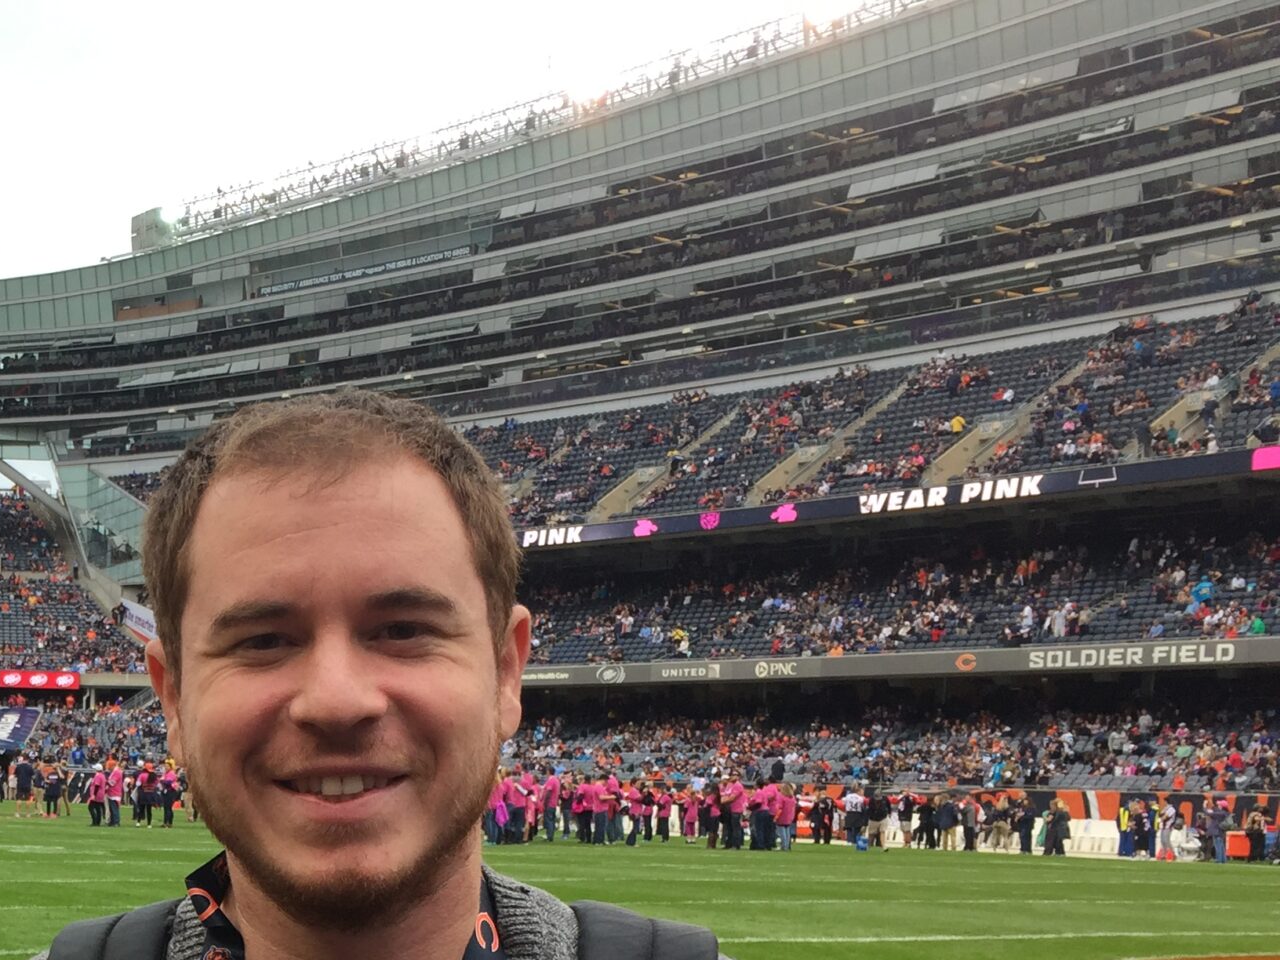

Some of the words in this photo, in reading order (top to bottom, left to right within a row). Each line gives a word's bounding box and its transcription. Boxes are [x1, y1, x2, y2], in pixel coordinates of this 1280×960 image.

[858, 486, 948, 514] WEAR
[960, 474, 1045, 504] PINK
[522, 526, 584, 548] PINK
[1028, 647, 1144, 668] SOLDIER
[1152, 643, 1235, 665] FIELD
[662, 667, 706, 678] UNITED
[770, 662, 798, 676] PNC
